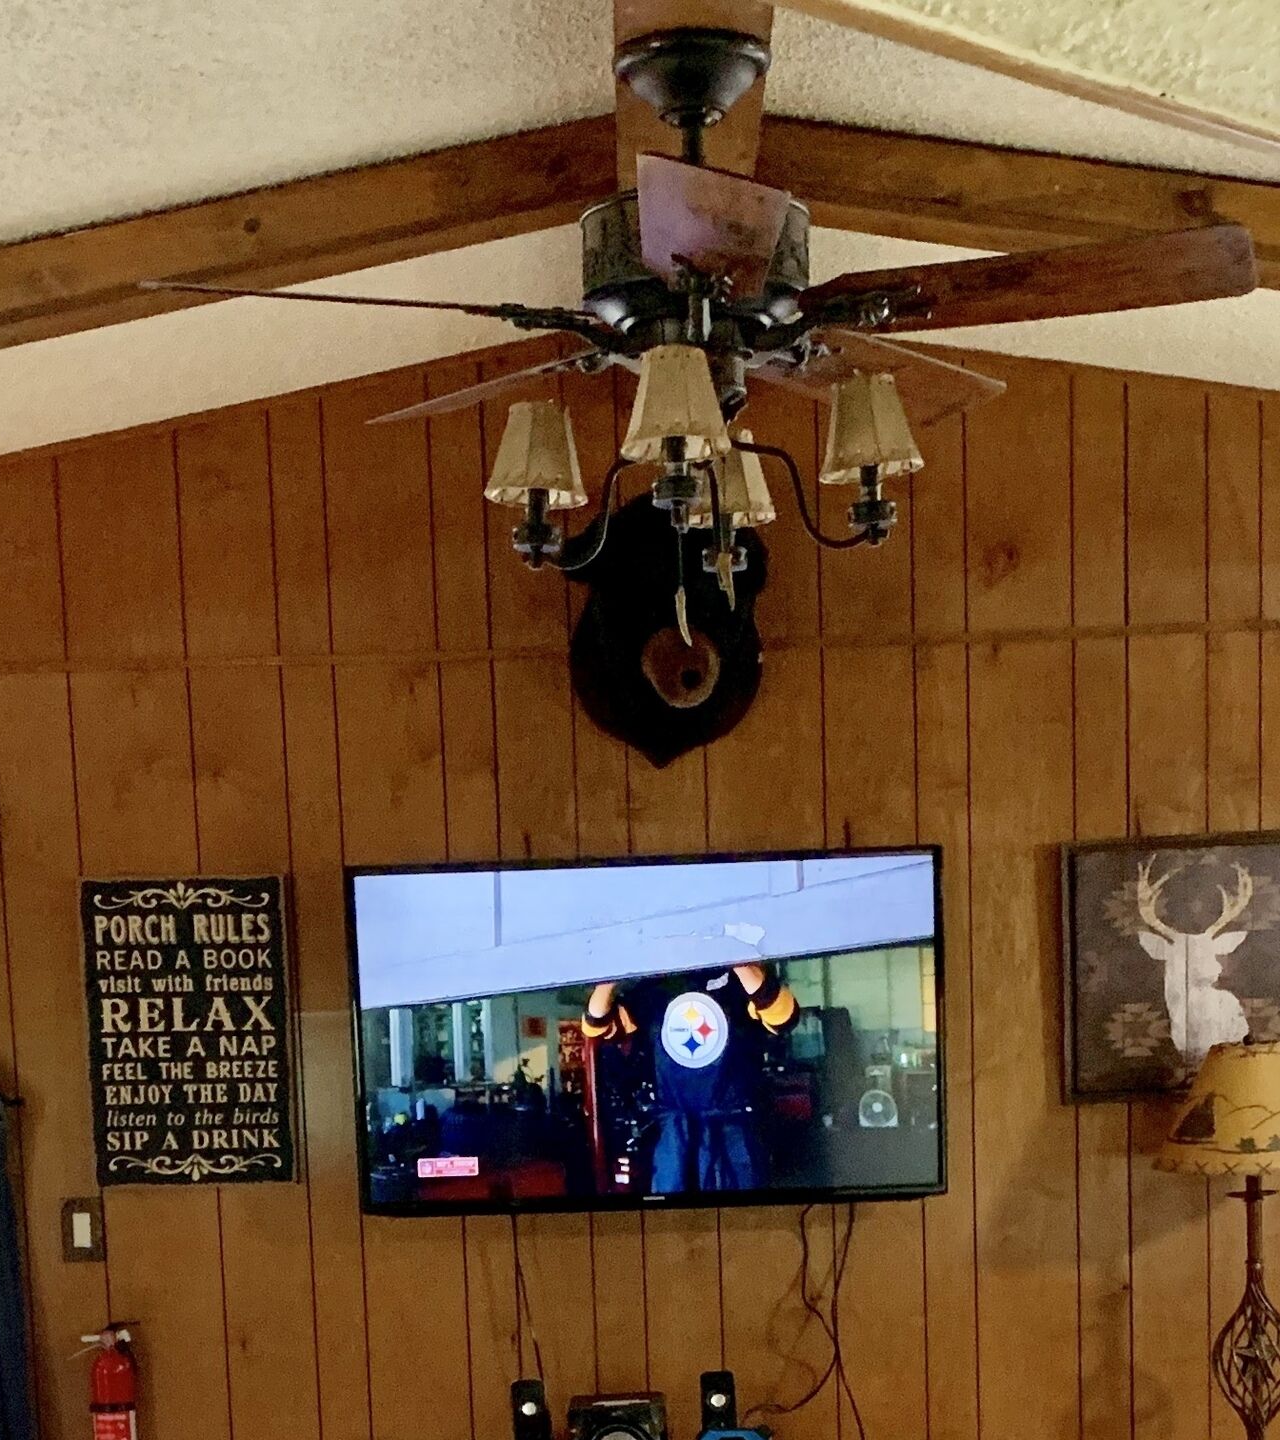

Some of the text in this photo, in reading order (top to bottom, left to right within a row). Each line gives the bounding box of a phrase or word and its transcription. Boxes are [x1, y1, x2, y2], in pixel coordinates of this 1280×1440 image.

[94, 913, 270, 946] PORCH RULES
[96, 948, 272, 970] READ A BOOK
[98, 974, 273, 993] visit with friends
[101, 996, 275, 1033] RELAX
[102, 1035, 276, 1058] TAKE A NAP
[102, 1061, 278, 1081] FEEL THE BREEZE
[105, 1083, 278, 1105] ENJOY THE DAY
[107, 1108, 280, 1127] listen to the birds
[107, 1128, 281, 1151] SIP A DRINK
